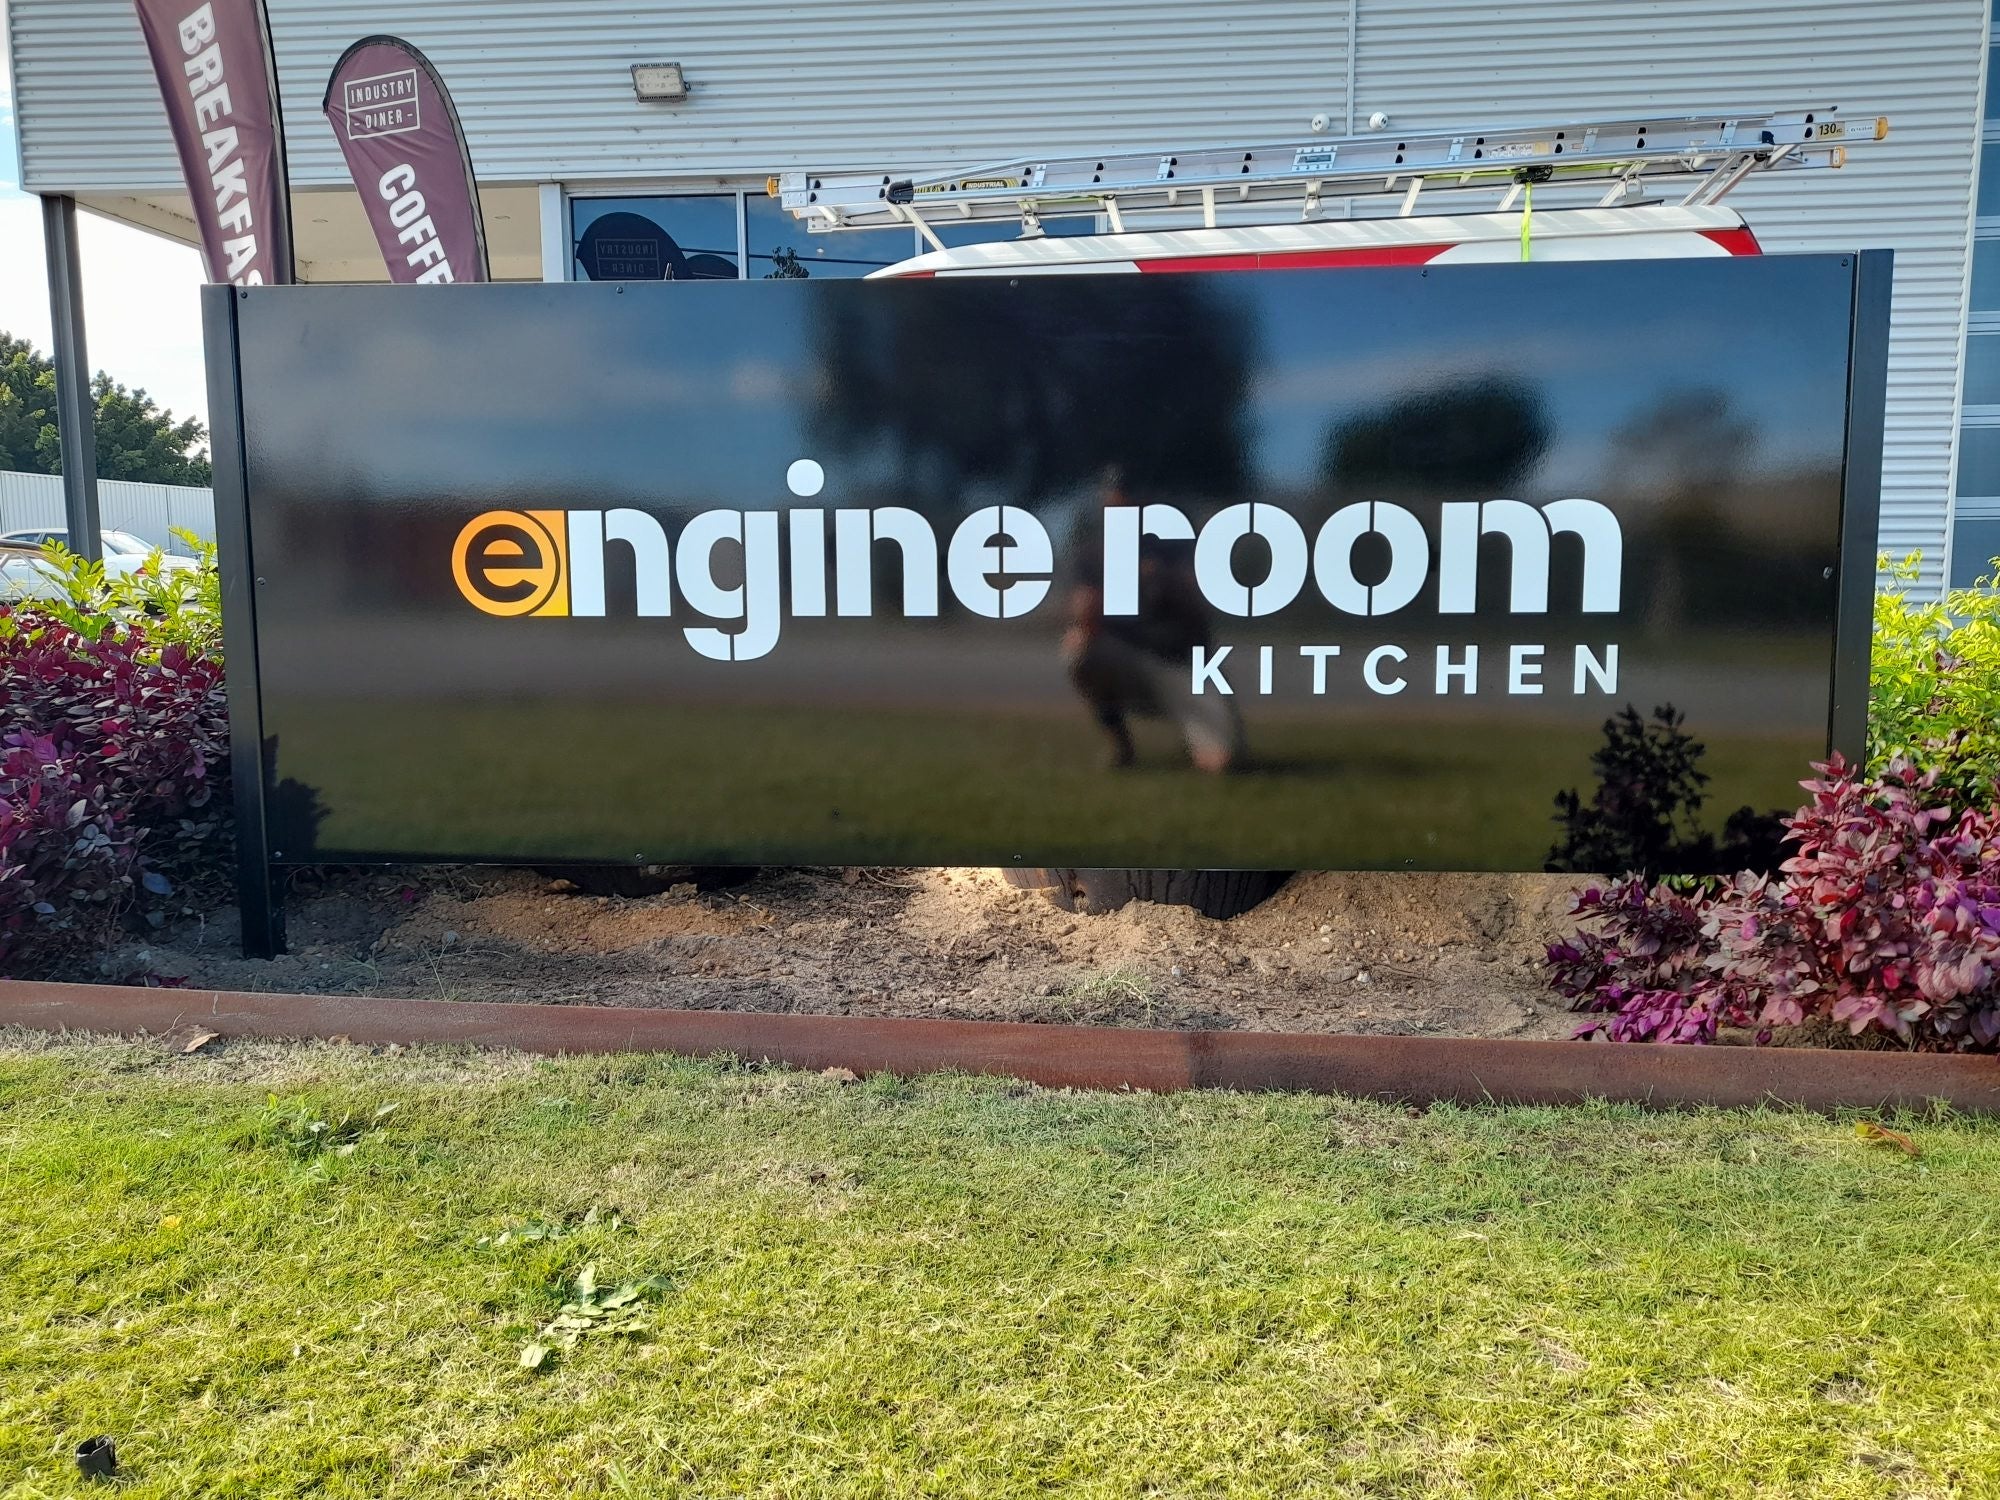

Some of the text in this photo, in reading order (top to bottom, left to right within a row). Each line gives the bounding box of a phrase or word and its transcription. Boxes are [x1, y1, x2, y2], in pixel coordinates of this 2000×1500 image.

[350, 78, 412, 104] INDUSTRY
[365, 109, 403, 129] DINER
[178, 1, 264, 286] BREAKFA
[965, 180, 1005, 189] INDUSTRIAL
[452, 458, 1623, 661] engine room
[1191, 644, 1619, 695] KITCHEN
